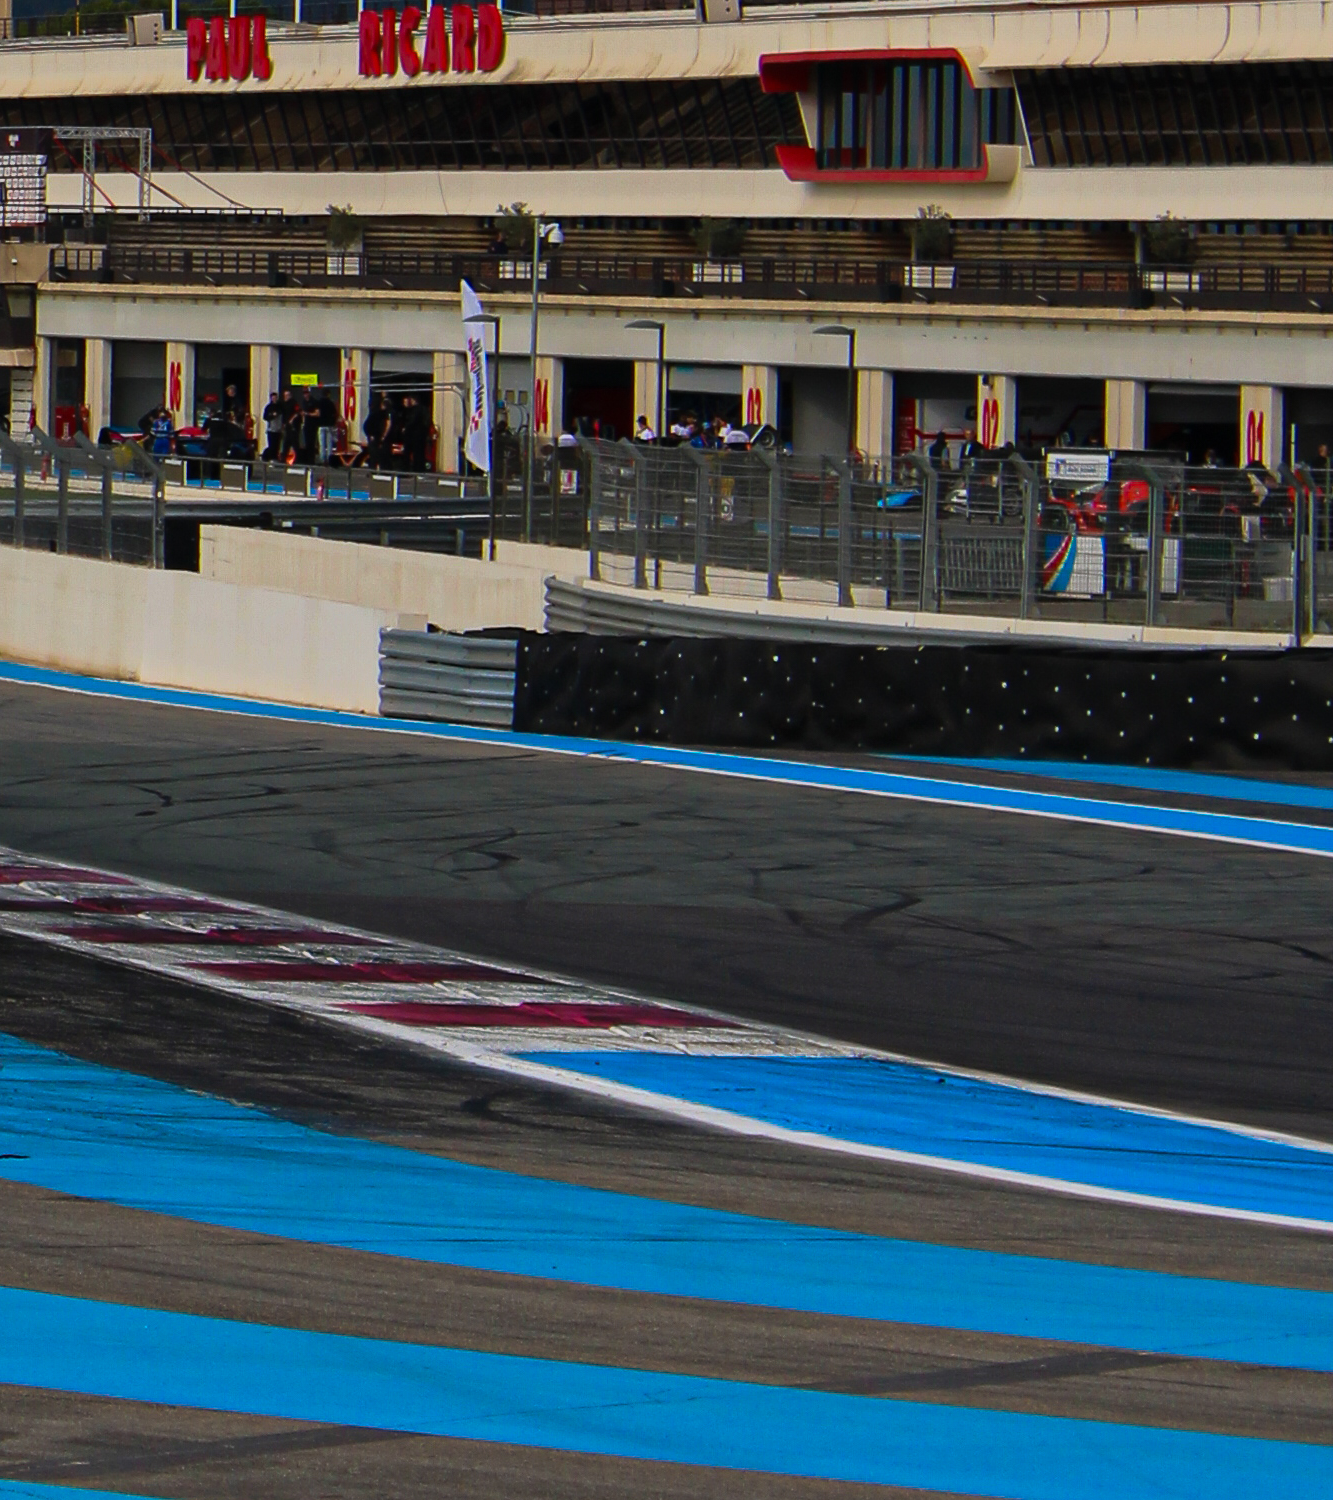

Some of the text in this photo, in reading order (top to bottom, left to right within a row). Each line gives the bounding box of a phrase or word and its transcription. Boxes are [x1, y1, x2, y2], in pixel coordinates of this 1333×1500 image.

[187, 3, 504, 82] PAUL RICARD
[535, 379, 548, 434] 04
[983, 399, 999, 449] 02
[1247, 410, 1264, 463] 01
